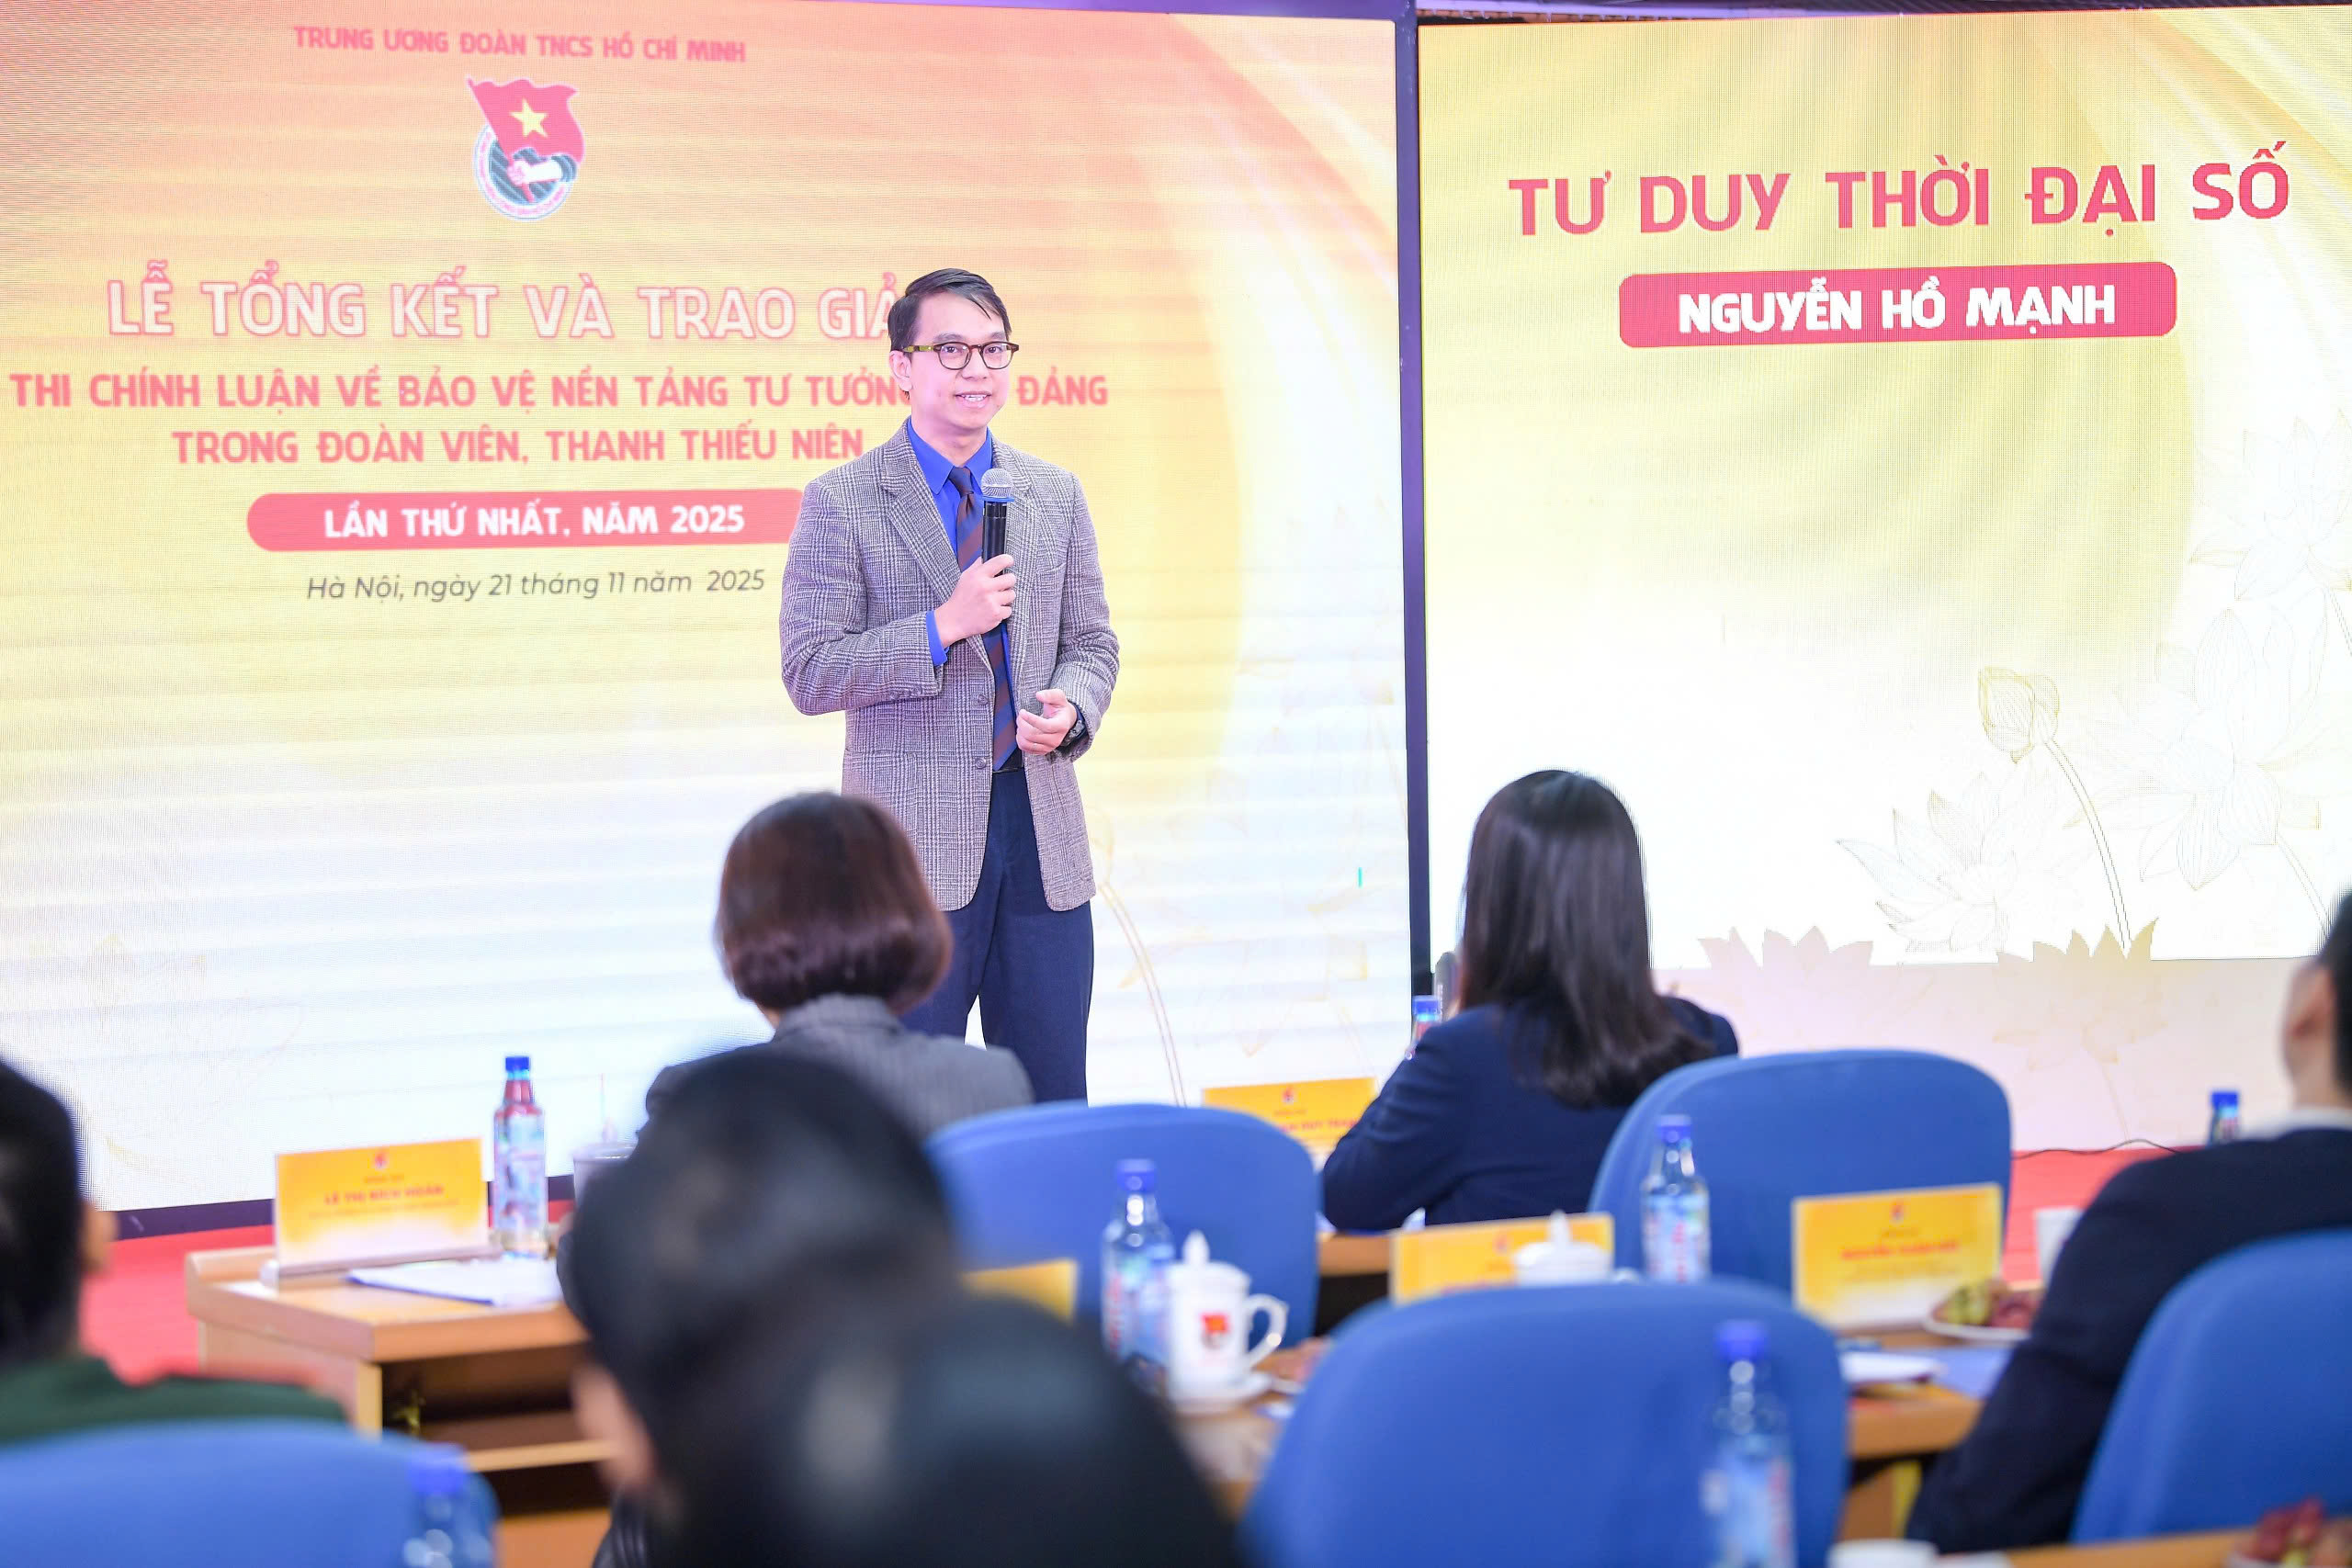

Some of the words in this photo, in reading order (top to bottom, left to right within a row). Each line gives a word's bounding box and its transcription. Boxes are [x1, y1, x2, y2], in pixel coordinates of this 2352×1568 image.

[293, 25, 374, 50] TRUNG
[536, 34, 593, 58] TNCS
[643, 35, 677, 60] CHÍ
[687, 39, 746, 62] MINH
[1509, 171, 1611, 235] TƯ
[1640, 173, 1791, 233] DUY
[1826, 154, 1989, 229] THỜI
[2025, 164, 2155, 236] ĐẠI
[2192, 141, 2289, 220] SỐ
[107, 259, 175, 337] LỄ
[198, 258, 367, 339] TỔNG
[390, 265, 501, 340] KẾT
[522, 272, 616, 343] VÀ
[635, 286, 799, 344] TRAO
[818, 271, 897, 340] GIẢ
[1678, 276, 1862, 333] NGUYỄN
[1966, 285, 2116, 334] MẠNH
[9, 373, 71, 407] THI
[88, 367, 200, 407] CHÍNH
[217, 367, 320, 415] LUẬN
[335, 365, 382, 407] VỀ
[398, 366, 477, 407] BẢO
[492, 369, 536, 415] VỆ
[551, 366, 618, 407] NỀN
[634, 367, 729, 407] TẢNG
[743, 374, 791, 407] TƯ
[1016, 367, 1108, 406] ĐẢNG
[172, 431, 299, 464] TRONG
[316, 423, 424, 463] ĐOÀN
[545, 430, 664, 461] THANH
[680, 419, 776, 461] THIẾU
[792, 422, 863, 460] NIÊN
[325, 501, 388, 537] LẦN
[401, 502, 467, 536] THỨ
[582, 502, 658, 535] NĂM
[671, 504, 745, 533] 2025
[307, 576, 345, 599] Hà
[355, 574, 404, 603] Nội,
[413, 574, 481, 603] ngày
[488, 573, 512, 596] 21
[521, 573, 599, 600] tháng
[608, 571, 626, 592] 11
[634, 570, 692, 592] năm
[707, 569, 764, 592] 2025
